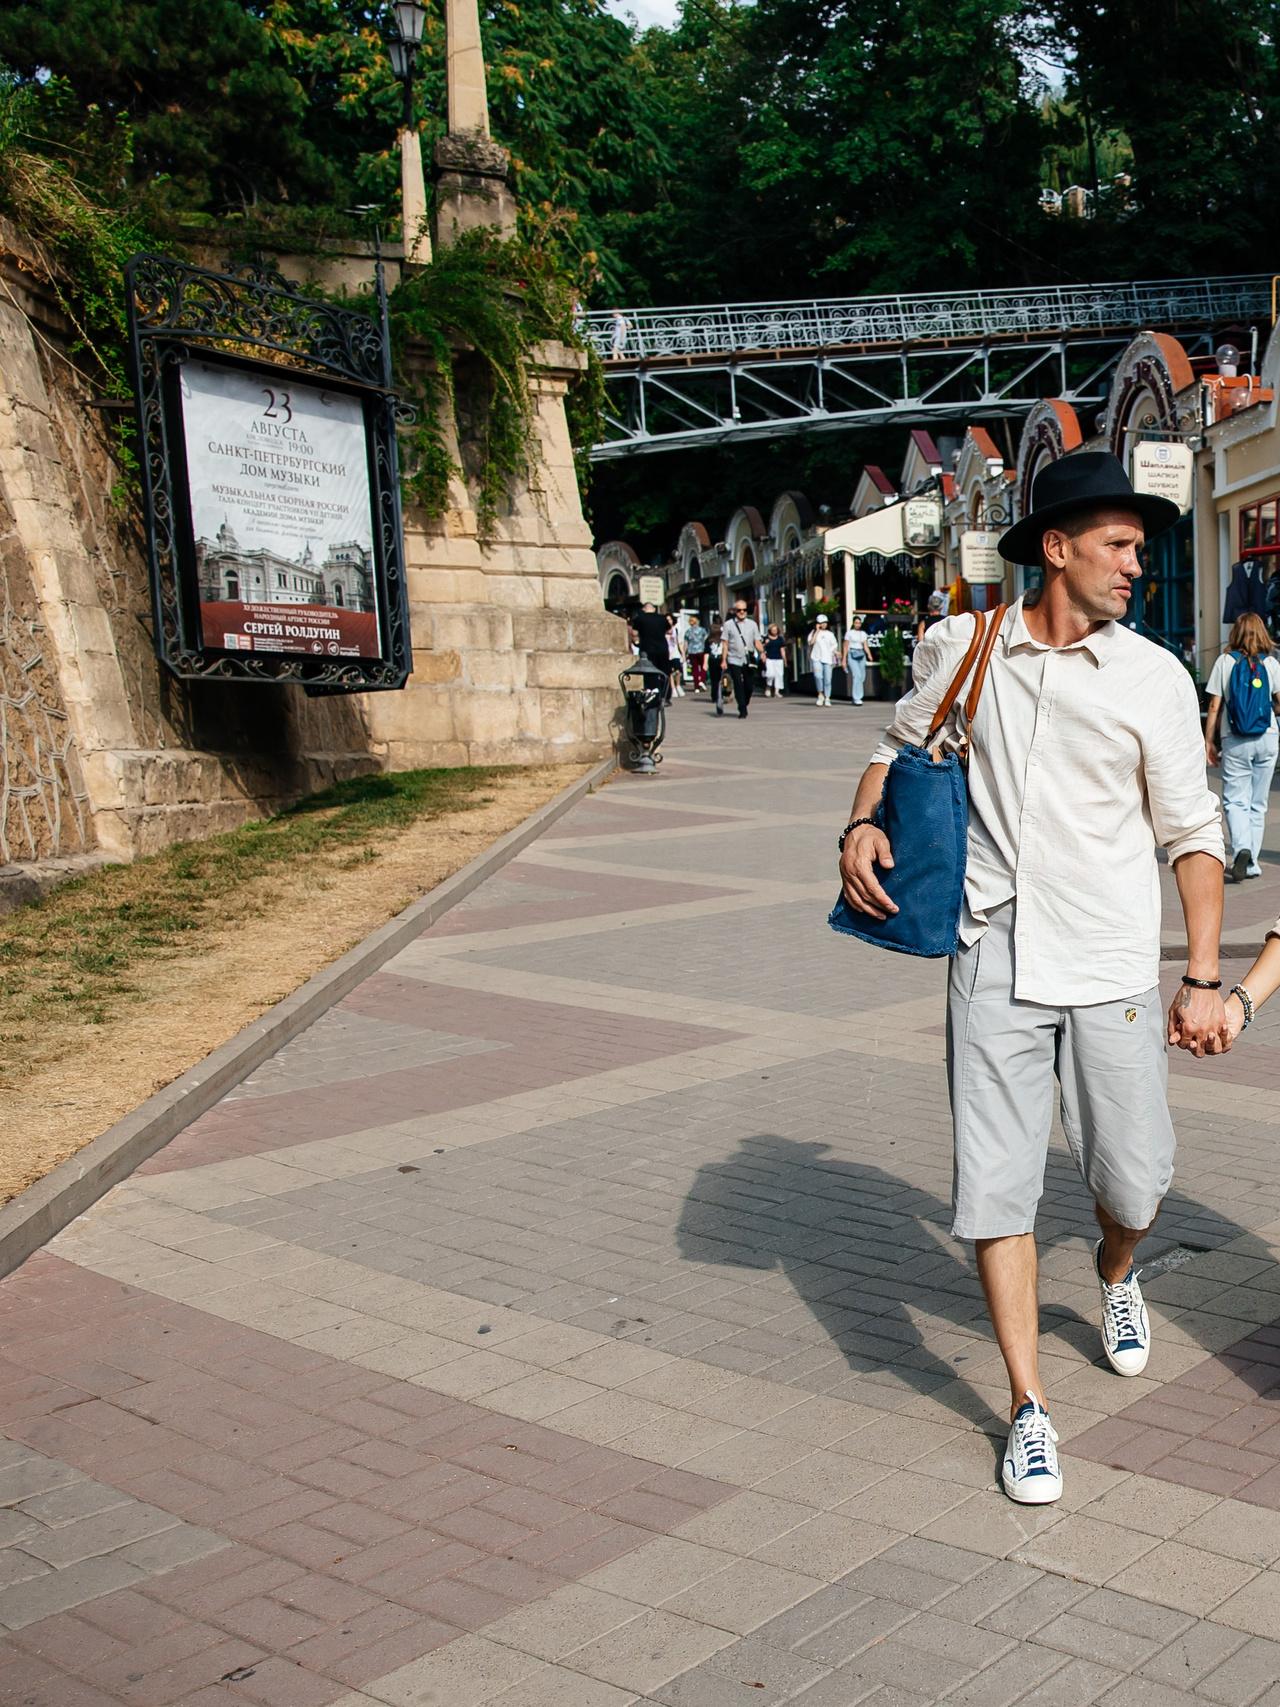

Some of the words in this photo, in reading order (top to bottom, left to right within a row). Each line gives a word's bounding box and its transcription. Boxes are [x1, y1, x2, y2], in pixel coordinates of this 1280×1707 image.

[261, 389, 293, 424] 23
[251, 421, 308, 443] АВГУСТА
[208, 441, 346, 477] САНКТ-ПЕТЕРБУРГСКИЙ
[288, 441, 314, 455] 19:00
[240, 463, 267, 478] ДОМ
[271, 468, 320, 487] МУЗЫКИ
[212, 484, 276, 502] МУЗЫКАЛЬНАЯ
[278, 495, 314, 508] СБОРНАЯ
[317, 501, 349, 514] РОССИИ
[218, 495, 266, 508] ГАЛА-КОНЦЕРТ
[243, 621, 283, 636] СЕРГЕЙ
[285, 625, 341, 640] РОЛДУГИН
